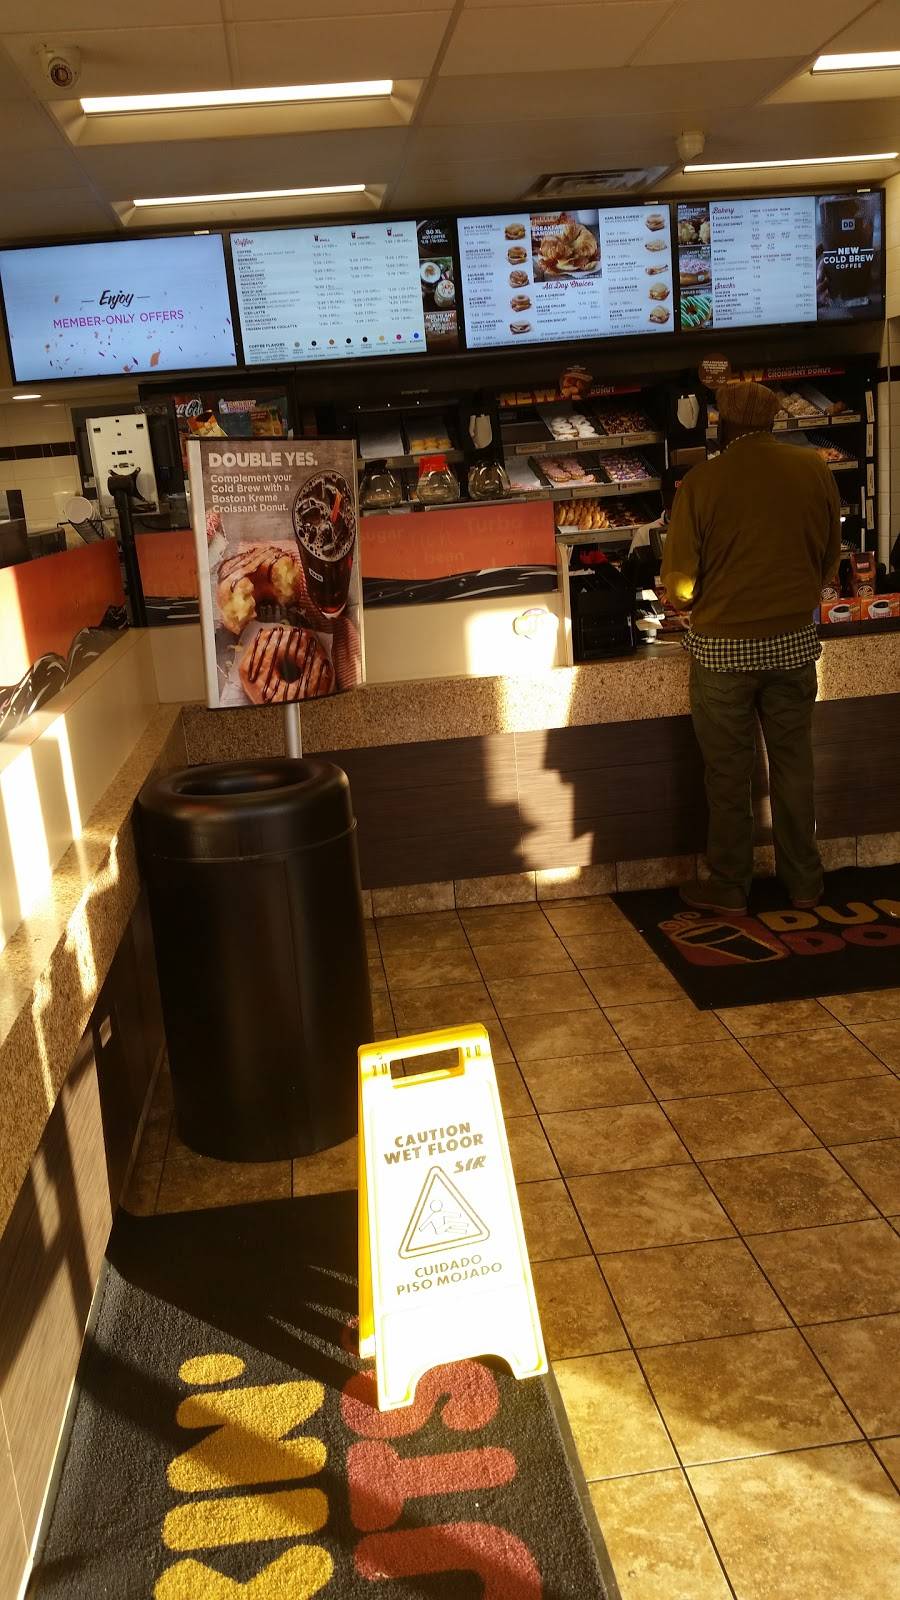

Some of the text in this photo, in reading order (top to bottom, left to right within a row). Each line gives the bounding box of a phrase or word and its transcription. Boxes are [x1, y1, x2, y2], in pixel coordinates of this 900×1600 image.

[554, 282, 568, 290] Day
[99, 290, 134, 309] Enjoy
[53, 310, 184, 328] MEMBER-ONLY OFFERS
[209, 452, 318, 467] DOUBLE YES.
[210, 474, 292, 484] Complement your
[211, 484, 234, 493] Cold
[237, 484, 260, 492] Brew
[263, 483, 282, 492] with
[212, 494, 278, 503] Boston Kreme
[212, 503, 289, 513] Croissant Donut.
[394, 1122, 471, 1148] CAUTION
[384, 1134, 483, 1165] WET FLOOR
[454, 1156, 486, 1174] SIR
[415, 1255, 482, 1278] CUIDADO
[396, 1263, 502, 1296] PISO MOJADO
